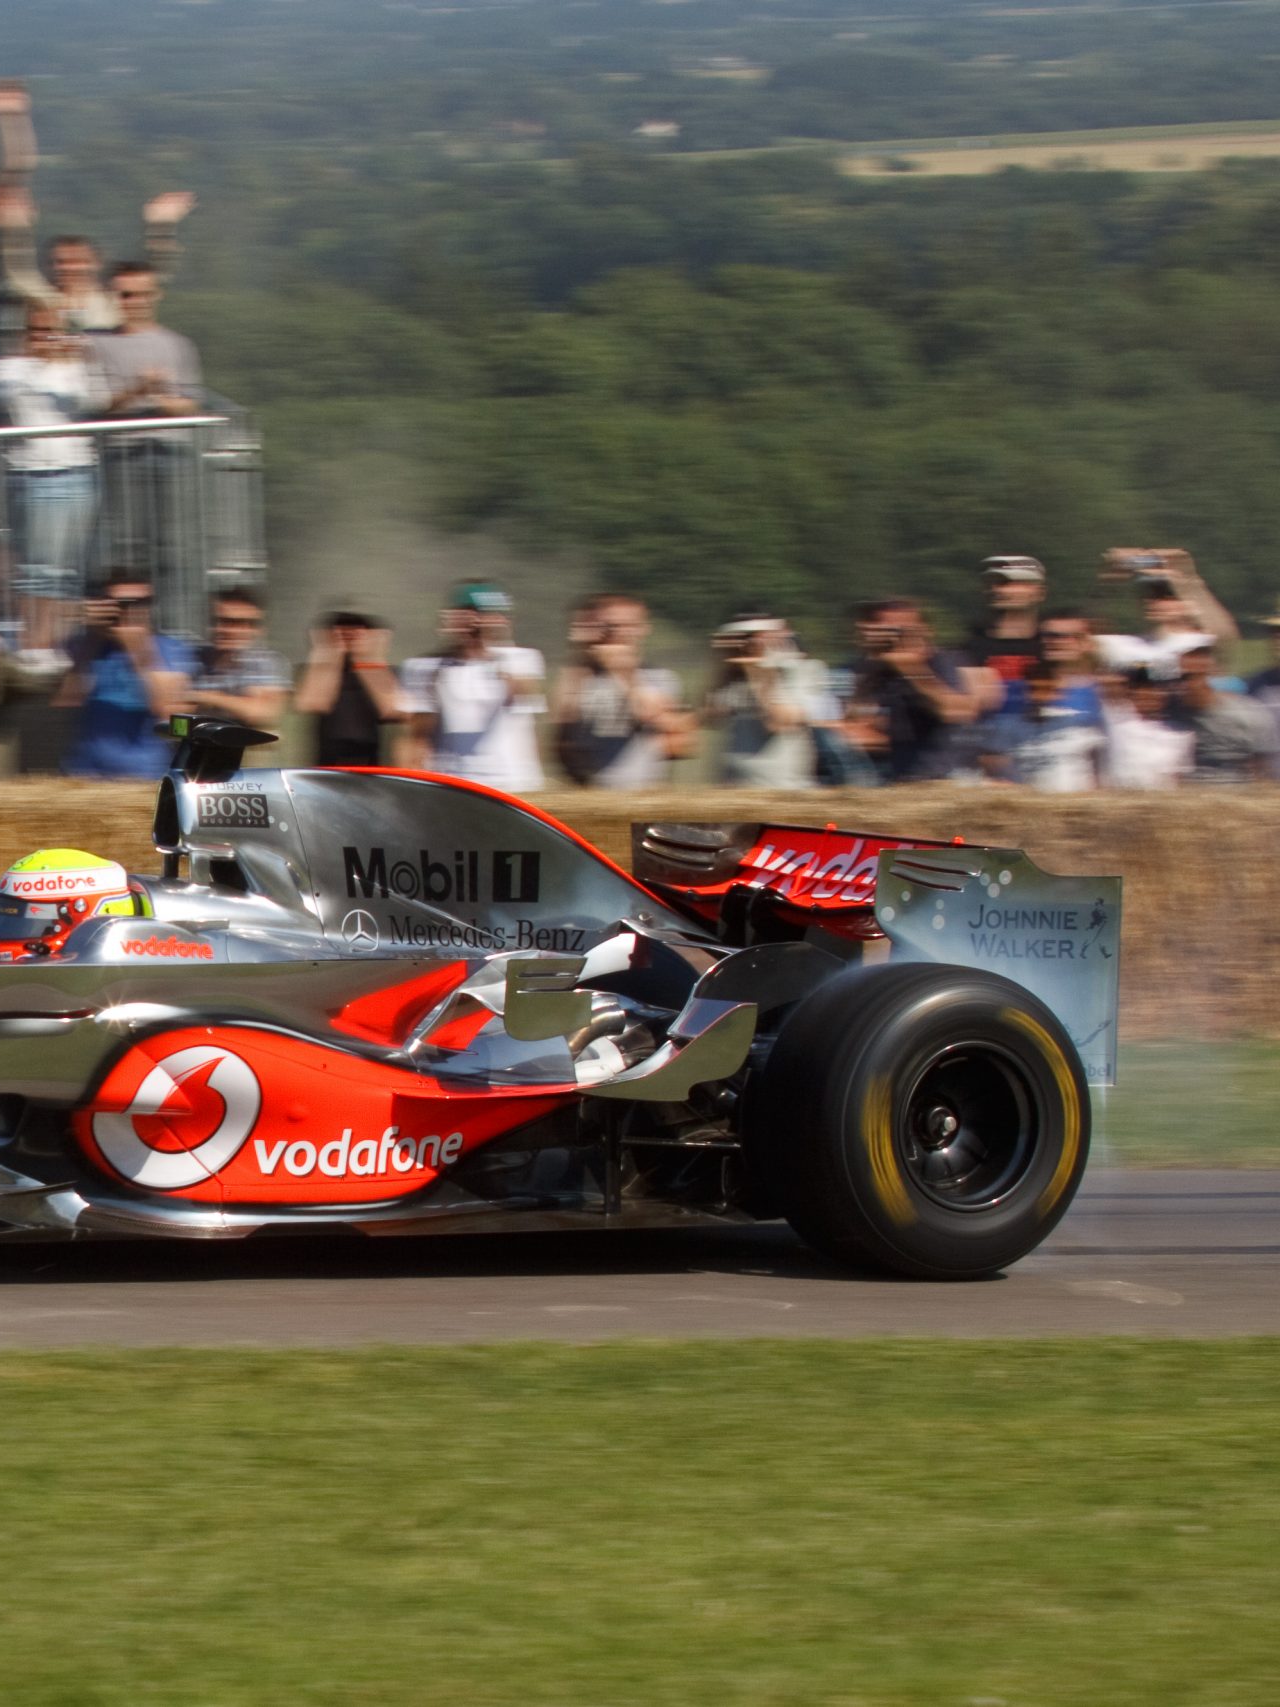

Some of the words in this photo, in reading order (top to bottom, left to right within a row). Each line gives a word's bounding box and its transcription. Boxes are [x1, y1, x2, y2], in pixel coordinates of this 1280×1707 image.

[200, 796, 265, 817] BOSS
[12, 875, 96, 893] vodafone
[343, 846, 478, 902] Mobil
[748, 838, 900, 903] voda
[968, 904, 1079, 931] JOHNNIE
[388, 914, 587, 951] Mercedes-Benz
[969, 932, 1075, 960] WALKER
[120, 934, 214, 960] vodafone
[1084, 1063, 1113, 1078] bel
[253, 1125, 464, 1177] vodafone
